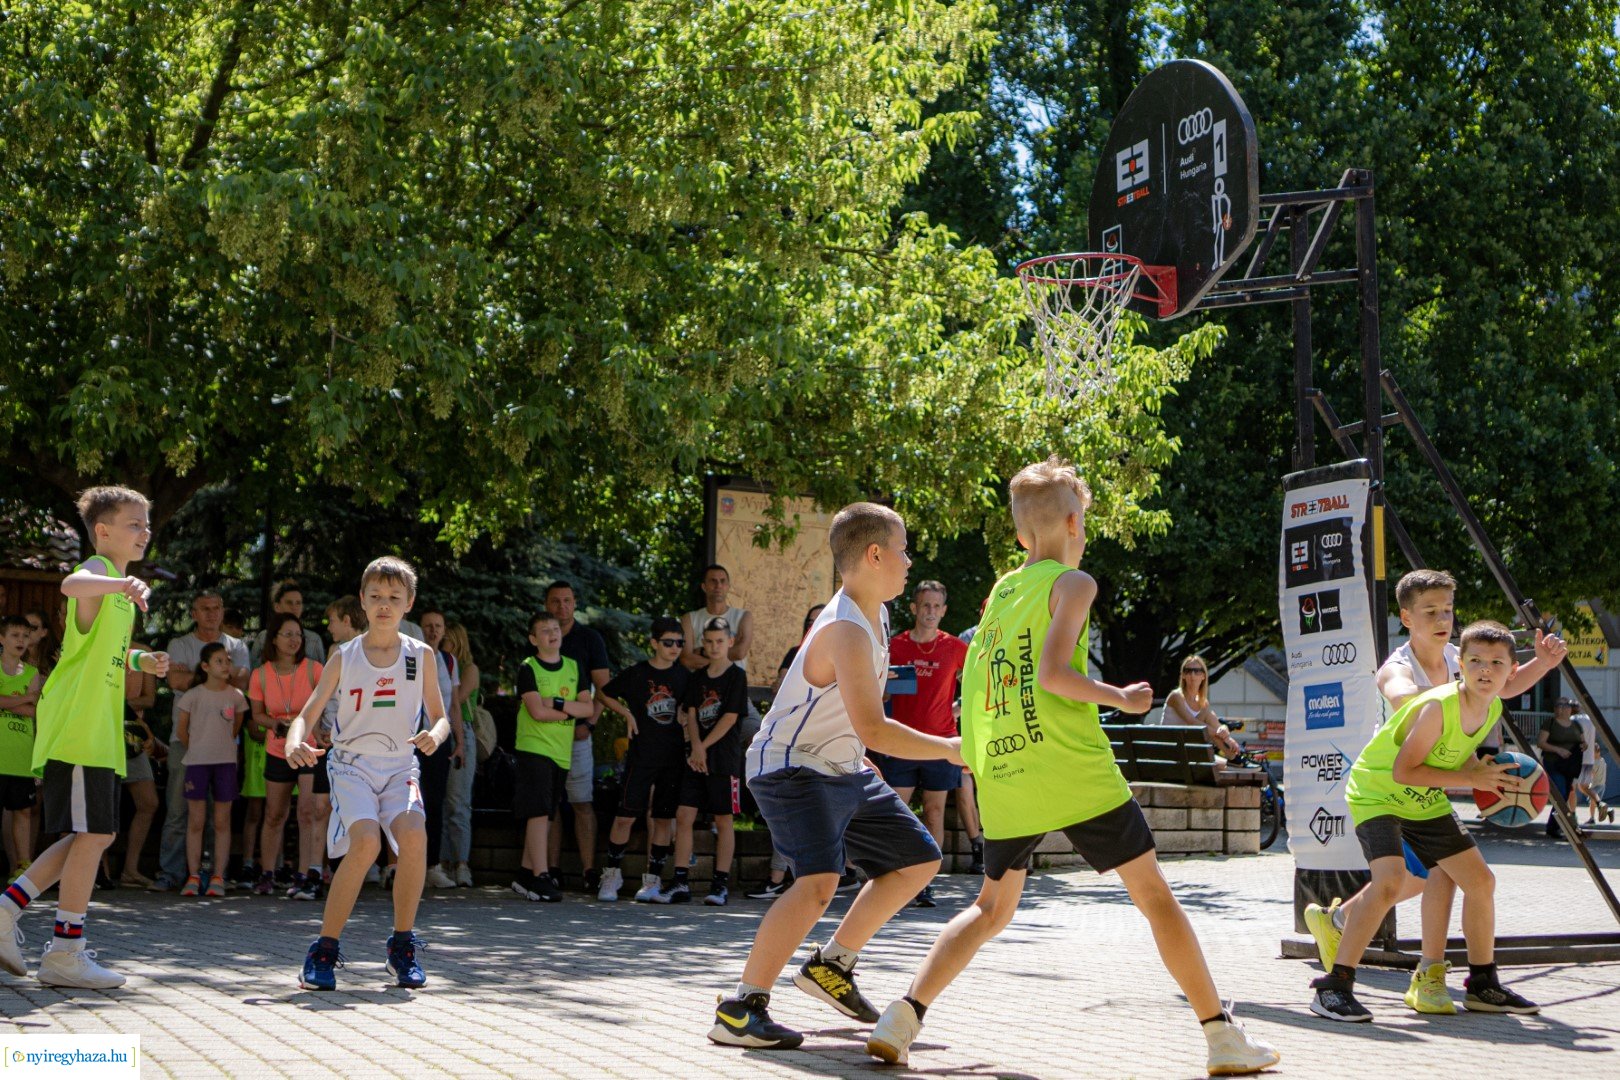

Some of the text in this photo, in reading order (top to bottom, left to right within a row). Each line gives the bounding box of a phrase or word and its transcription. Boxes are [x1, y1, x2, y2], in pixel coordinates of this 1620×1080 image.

[1180, 152, 1195, 167] Audi
[1180, 161, 1207, 180] Hungaria
[1291, 651, 1303, 659] Audi
[1018, 627, 1044, 745] STREETBALL
[349, 688, 363, 712] 7
[1308, 695, 1340, 711] molten
[992, 763, 1008, 772] Audi
[1301, 753, 1343, 769] POWER
[993, 767, 1025, 780] Hungaria
[1317, 767, 1343, 782] ADE
[1318, 815, 1346, 837] TOTI
